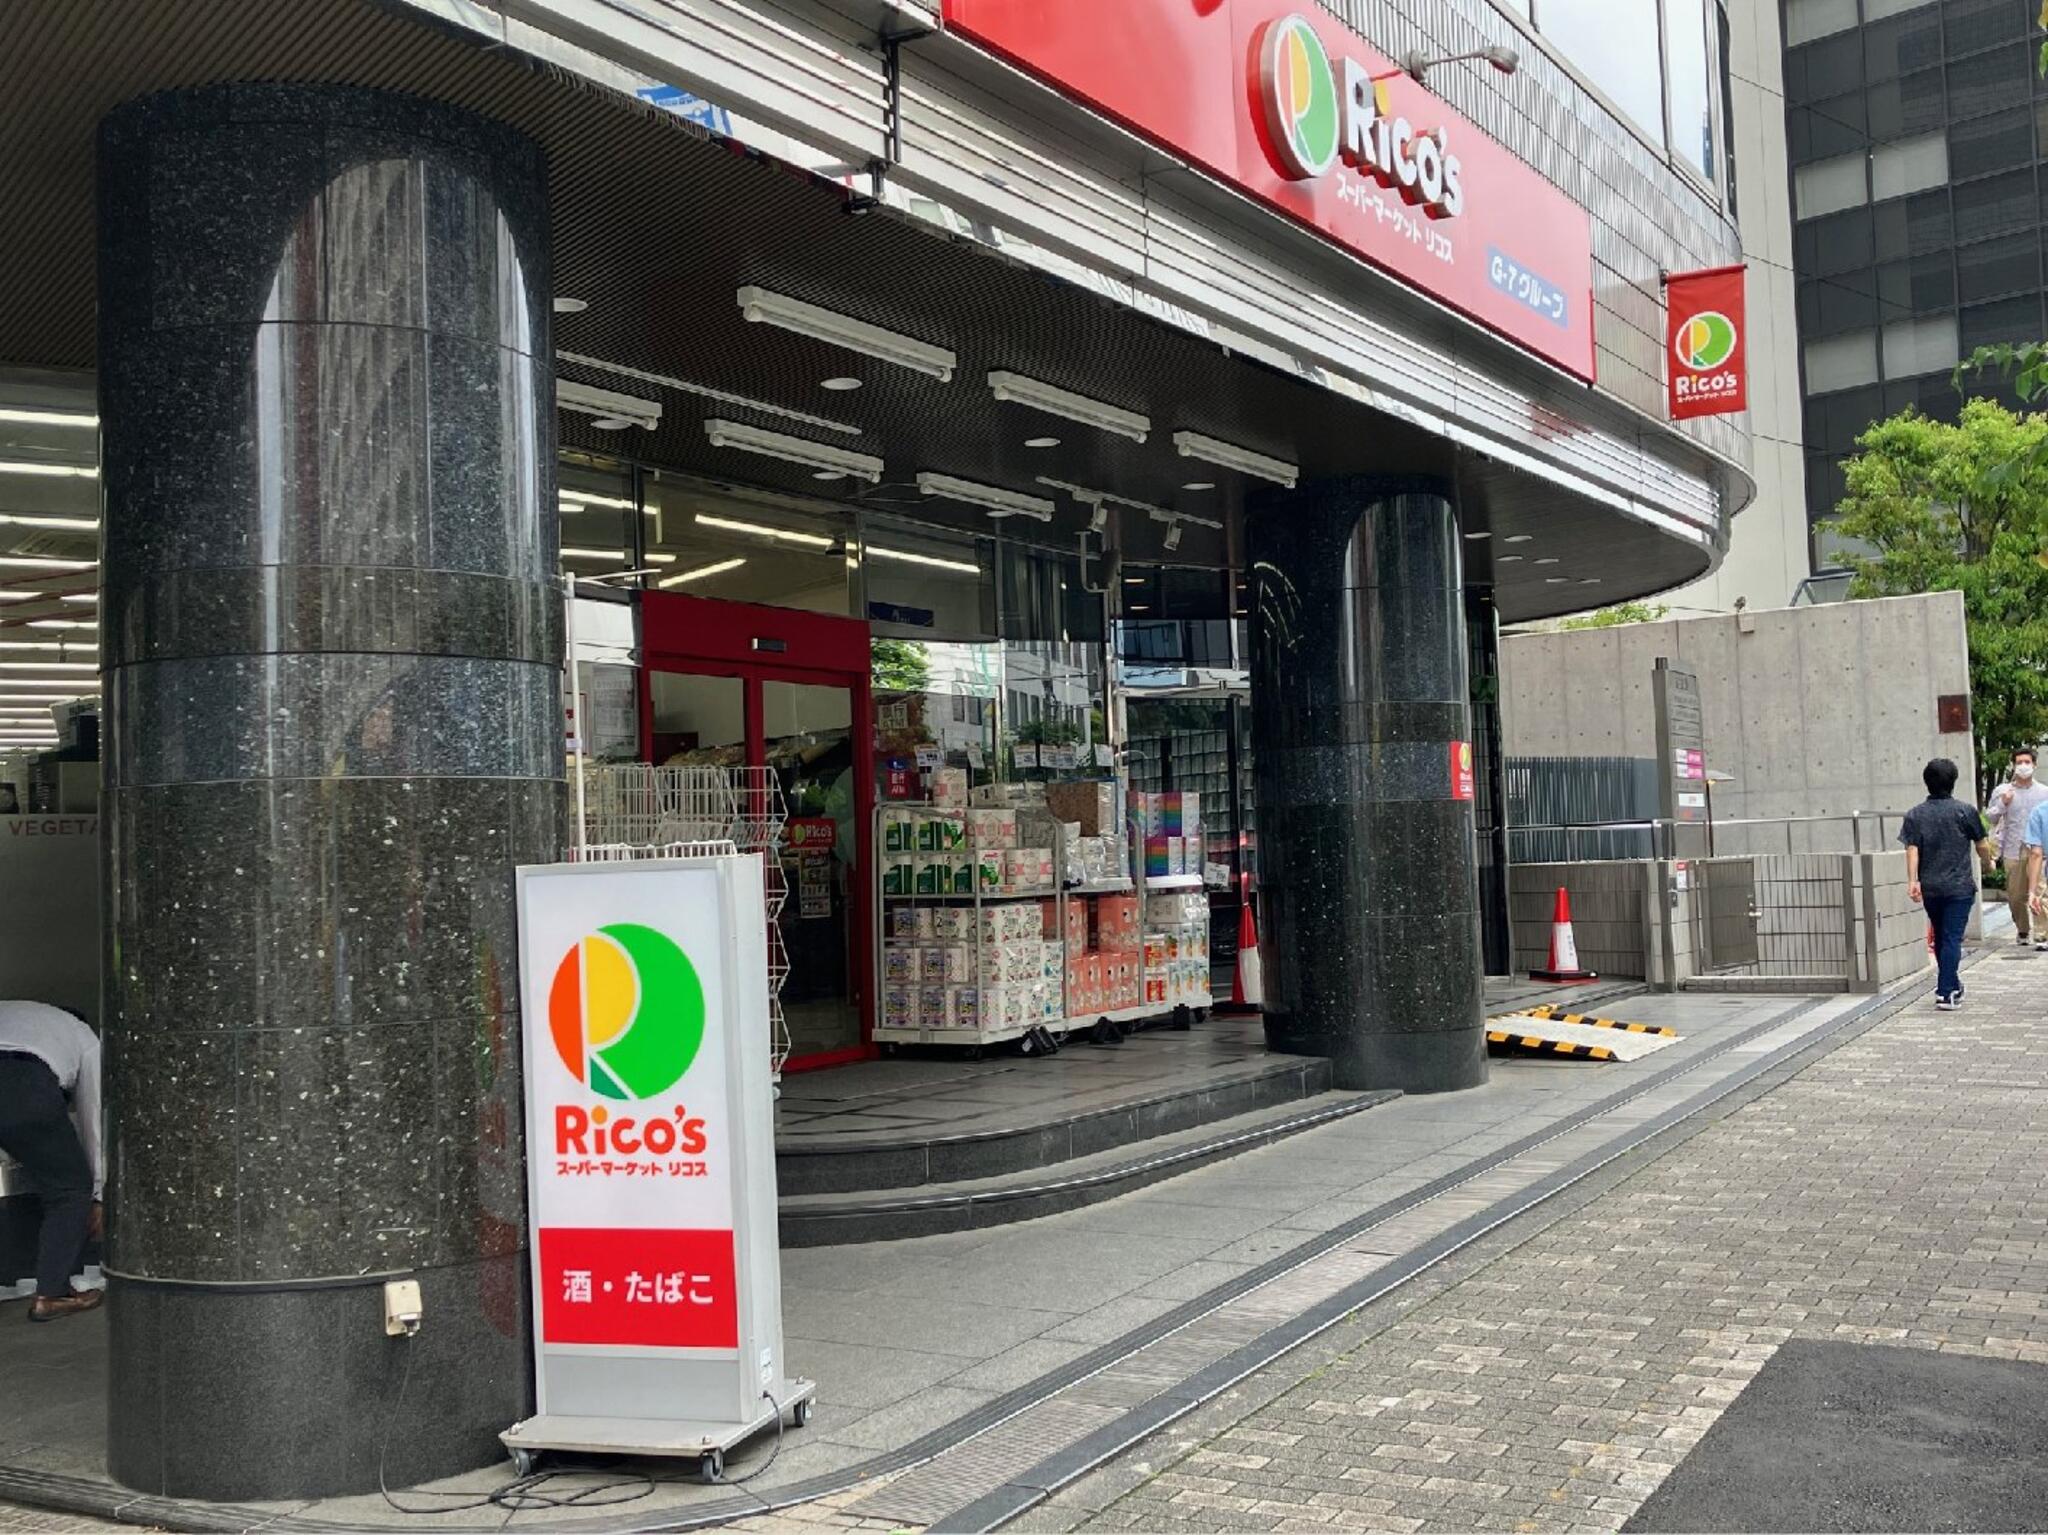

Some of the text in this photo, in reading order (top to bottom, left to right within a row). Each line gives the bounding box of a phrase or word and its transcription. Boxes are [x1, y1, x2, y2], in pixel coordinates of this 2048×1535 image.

[1343, 56, 1462, 217] Rico's
[1336, 173, 1454, 265] スーパーマーケット リコス
[1675, 371, 1737, 395] Rico's
[555, 1104, 708, 1155] Rico's
[556, 1158, 708, 1177] スーパーマーケット リコス
[562, 1269, 714, 1304] 酒・たばこ
